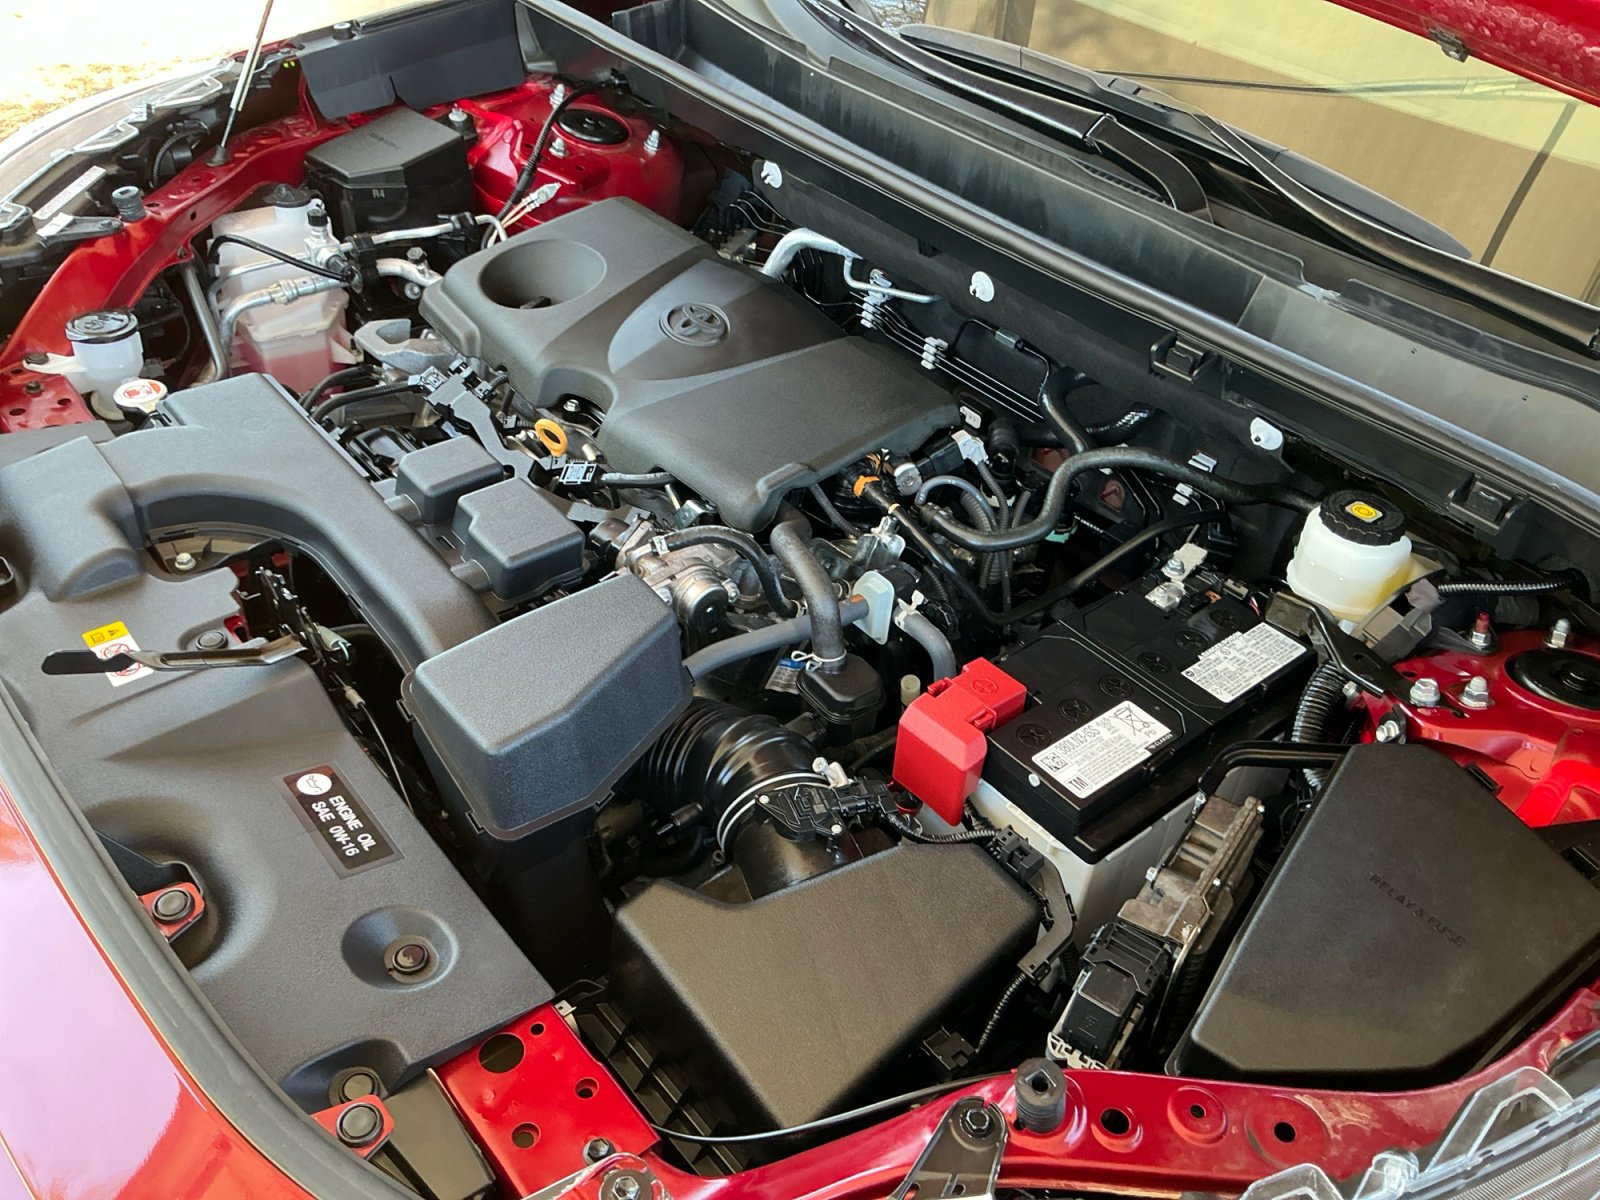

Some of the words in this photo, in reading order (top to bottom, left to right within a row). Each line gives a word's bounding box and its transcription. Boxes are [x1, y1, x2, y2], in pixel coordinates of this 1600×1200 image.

[372, 189, 385, 199] R4
[1067, 776, 1089, 791] TM
[311, 801, 335, 822] SAE
[329, 825, 360, 856] 0W-16
[329, 795, 363, 831] ENGINE
[357, 833, 376, 851] OIL
[1368, 872, 1416, 909] RELAY
[1427, 916, 1466, 948] FUSE
